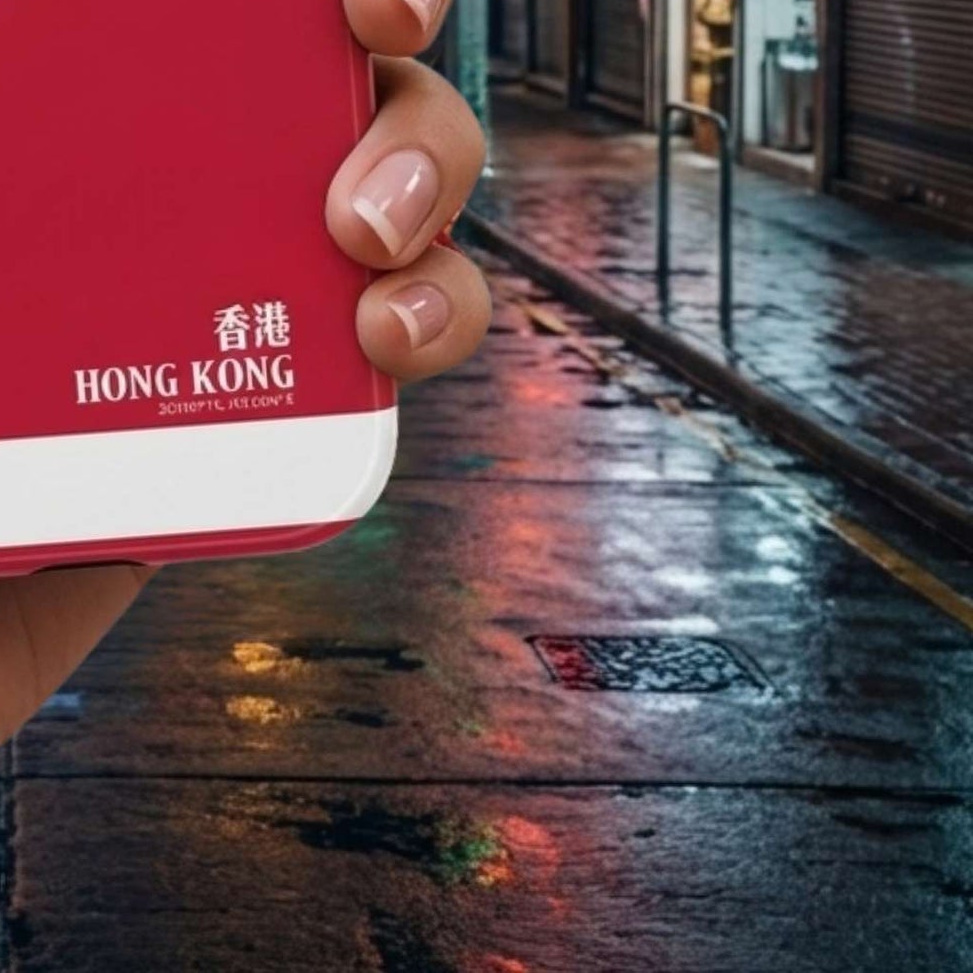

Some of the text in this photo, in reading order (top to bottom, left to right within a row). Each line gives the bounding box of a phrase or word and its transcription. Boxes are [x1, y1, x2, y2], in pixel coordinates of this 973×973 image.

[214, 301, 291, 352] 香港
[74, 363, 179, 404] HONG
[191, 354, 295, 395] KONG
